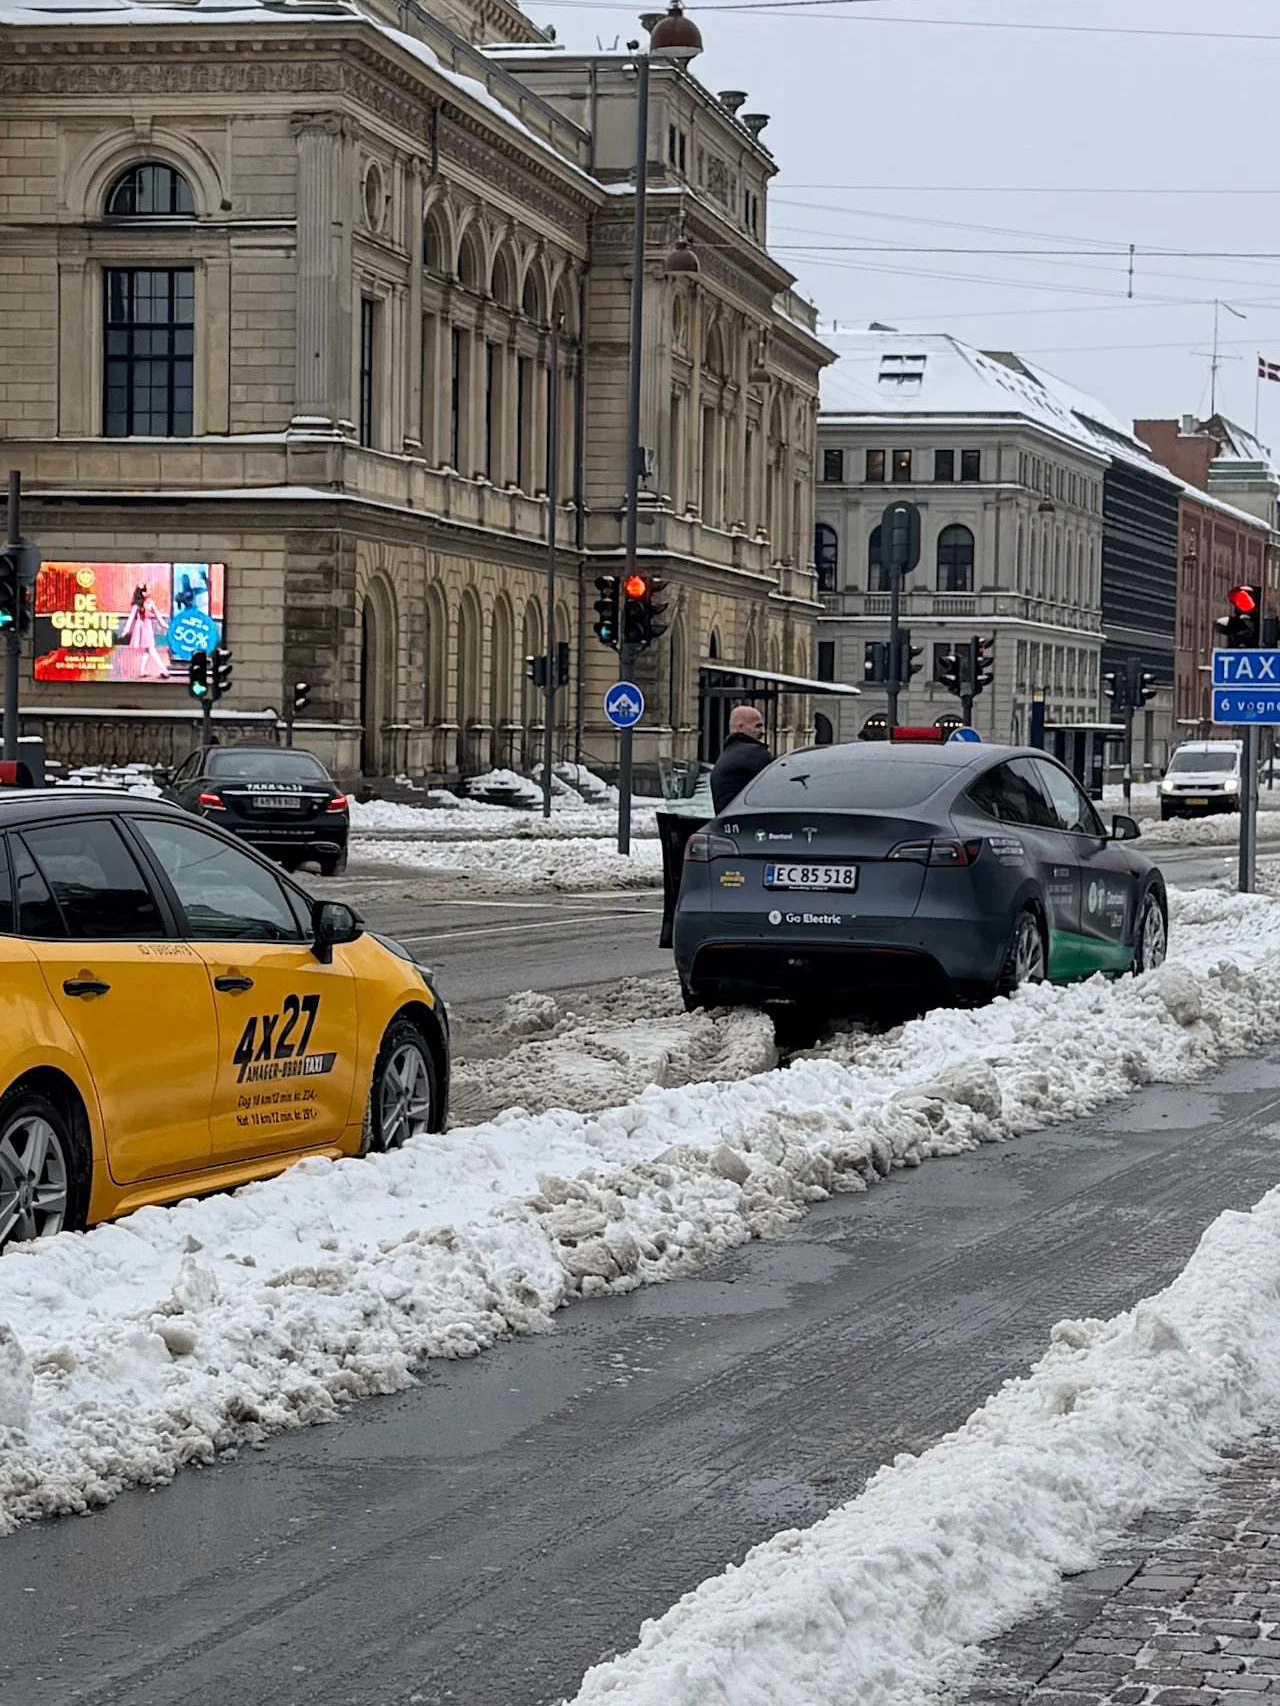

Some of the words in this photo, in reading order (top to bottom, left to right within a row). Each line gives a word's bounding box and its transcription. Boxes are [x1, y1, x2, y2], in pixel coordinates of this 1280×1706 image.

[74, 594, 97, 611] DE
[51, 610, 119, 630] GLEMTE
[173, 625, 209, 649] 50%
[1220, 698, 1230, 712] 6
[776, 867, 798, 882] EC
[800, 867, 819, 883] 85
[823, 869, 853, 885] 518
[786, 913, 801, 923] Go
[803, 913, 842, 924] Electric
[305, 1055, 324, 1074] TAXI
